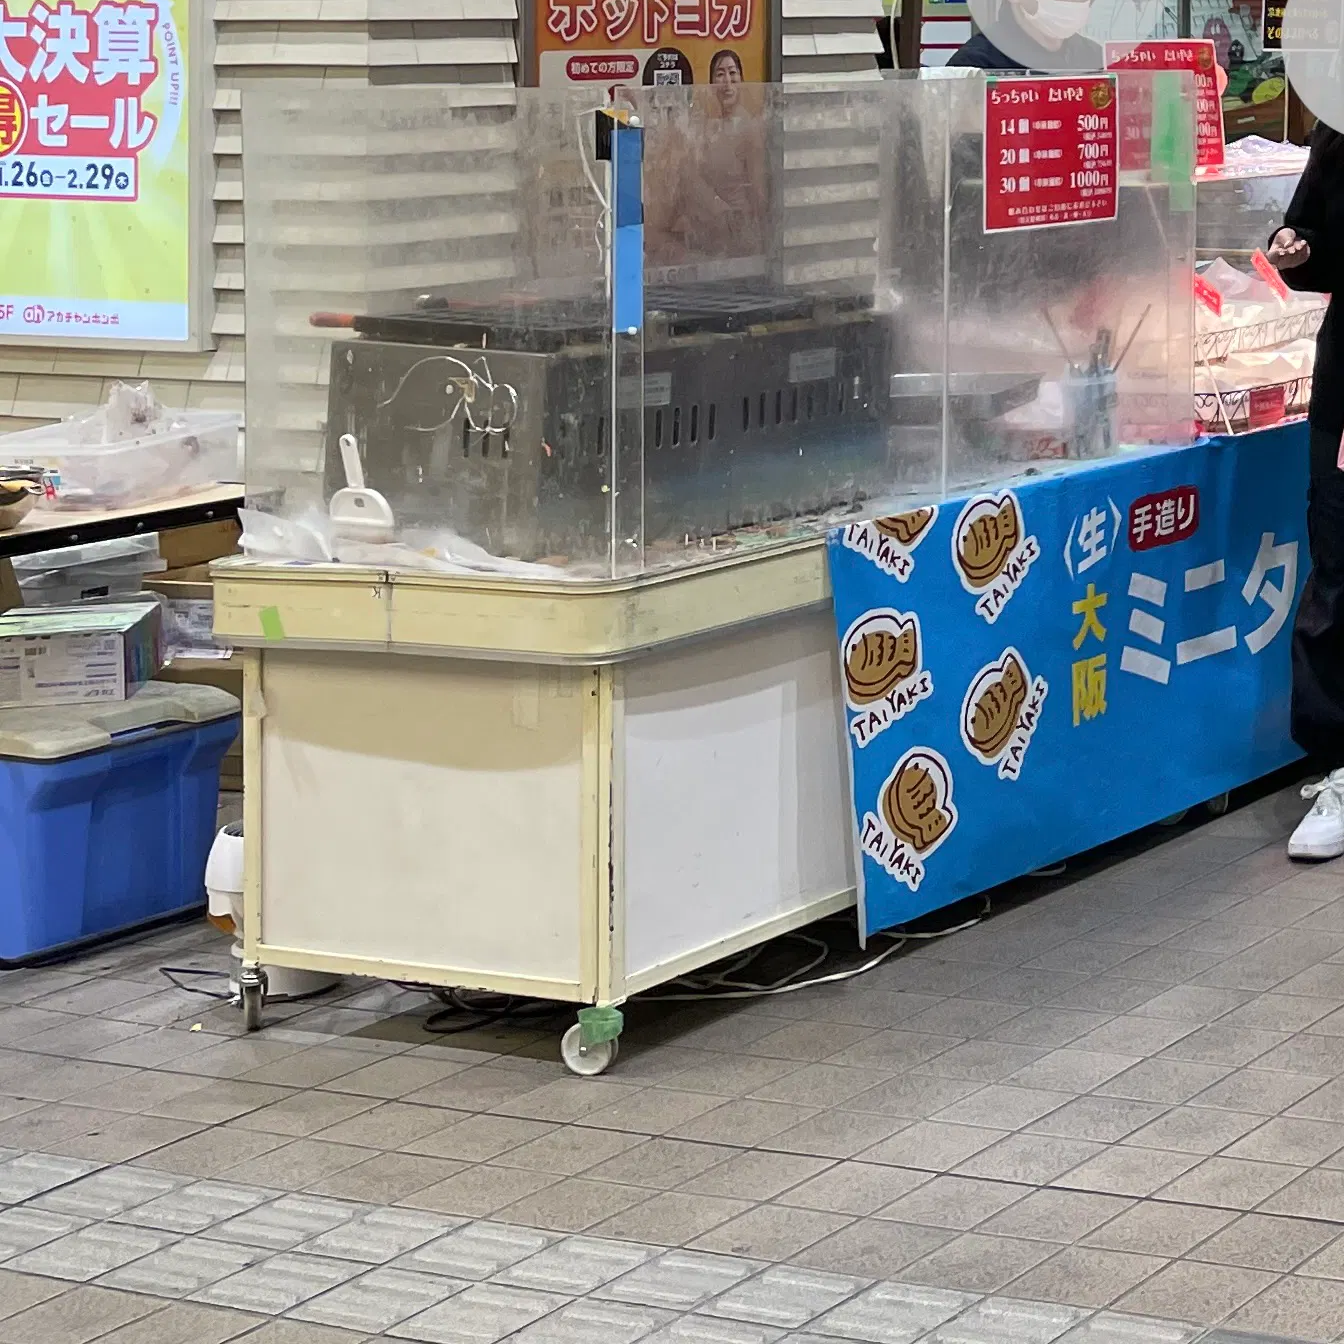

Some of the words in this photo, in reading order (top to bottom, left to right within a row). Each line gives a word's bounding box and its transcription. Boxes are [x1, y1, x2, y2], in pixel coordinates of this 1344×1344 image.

[162, 22, 179, 66] POINT
[1077, 114, 1109, 132] 500円
[1077, 142, 1109, 160] 700円
[1070, 170, 1109, 189] 1000円
[1132, 494, 1196, 544] 手造り
[848, 524, 912, 577] TAIYAKI
[980, 542, 1037, 616] TAIYAKI
[1072, 583, 1108, 728] 大阪
[853, 677, 930, 741] TAIYAKI
[1002, 682, 1046, 773] TAIYAKI
[862, 819, 922, 884] TAIYAKI
